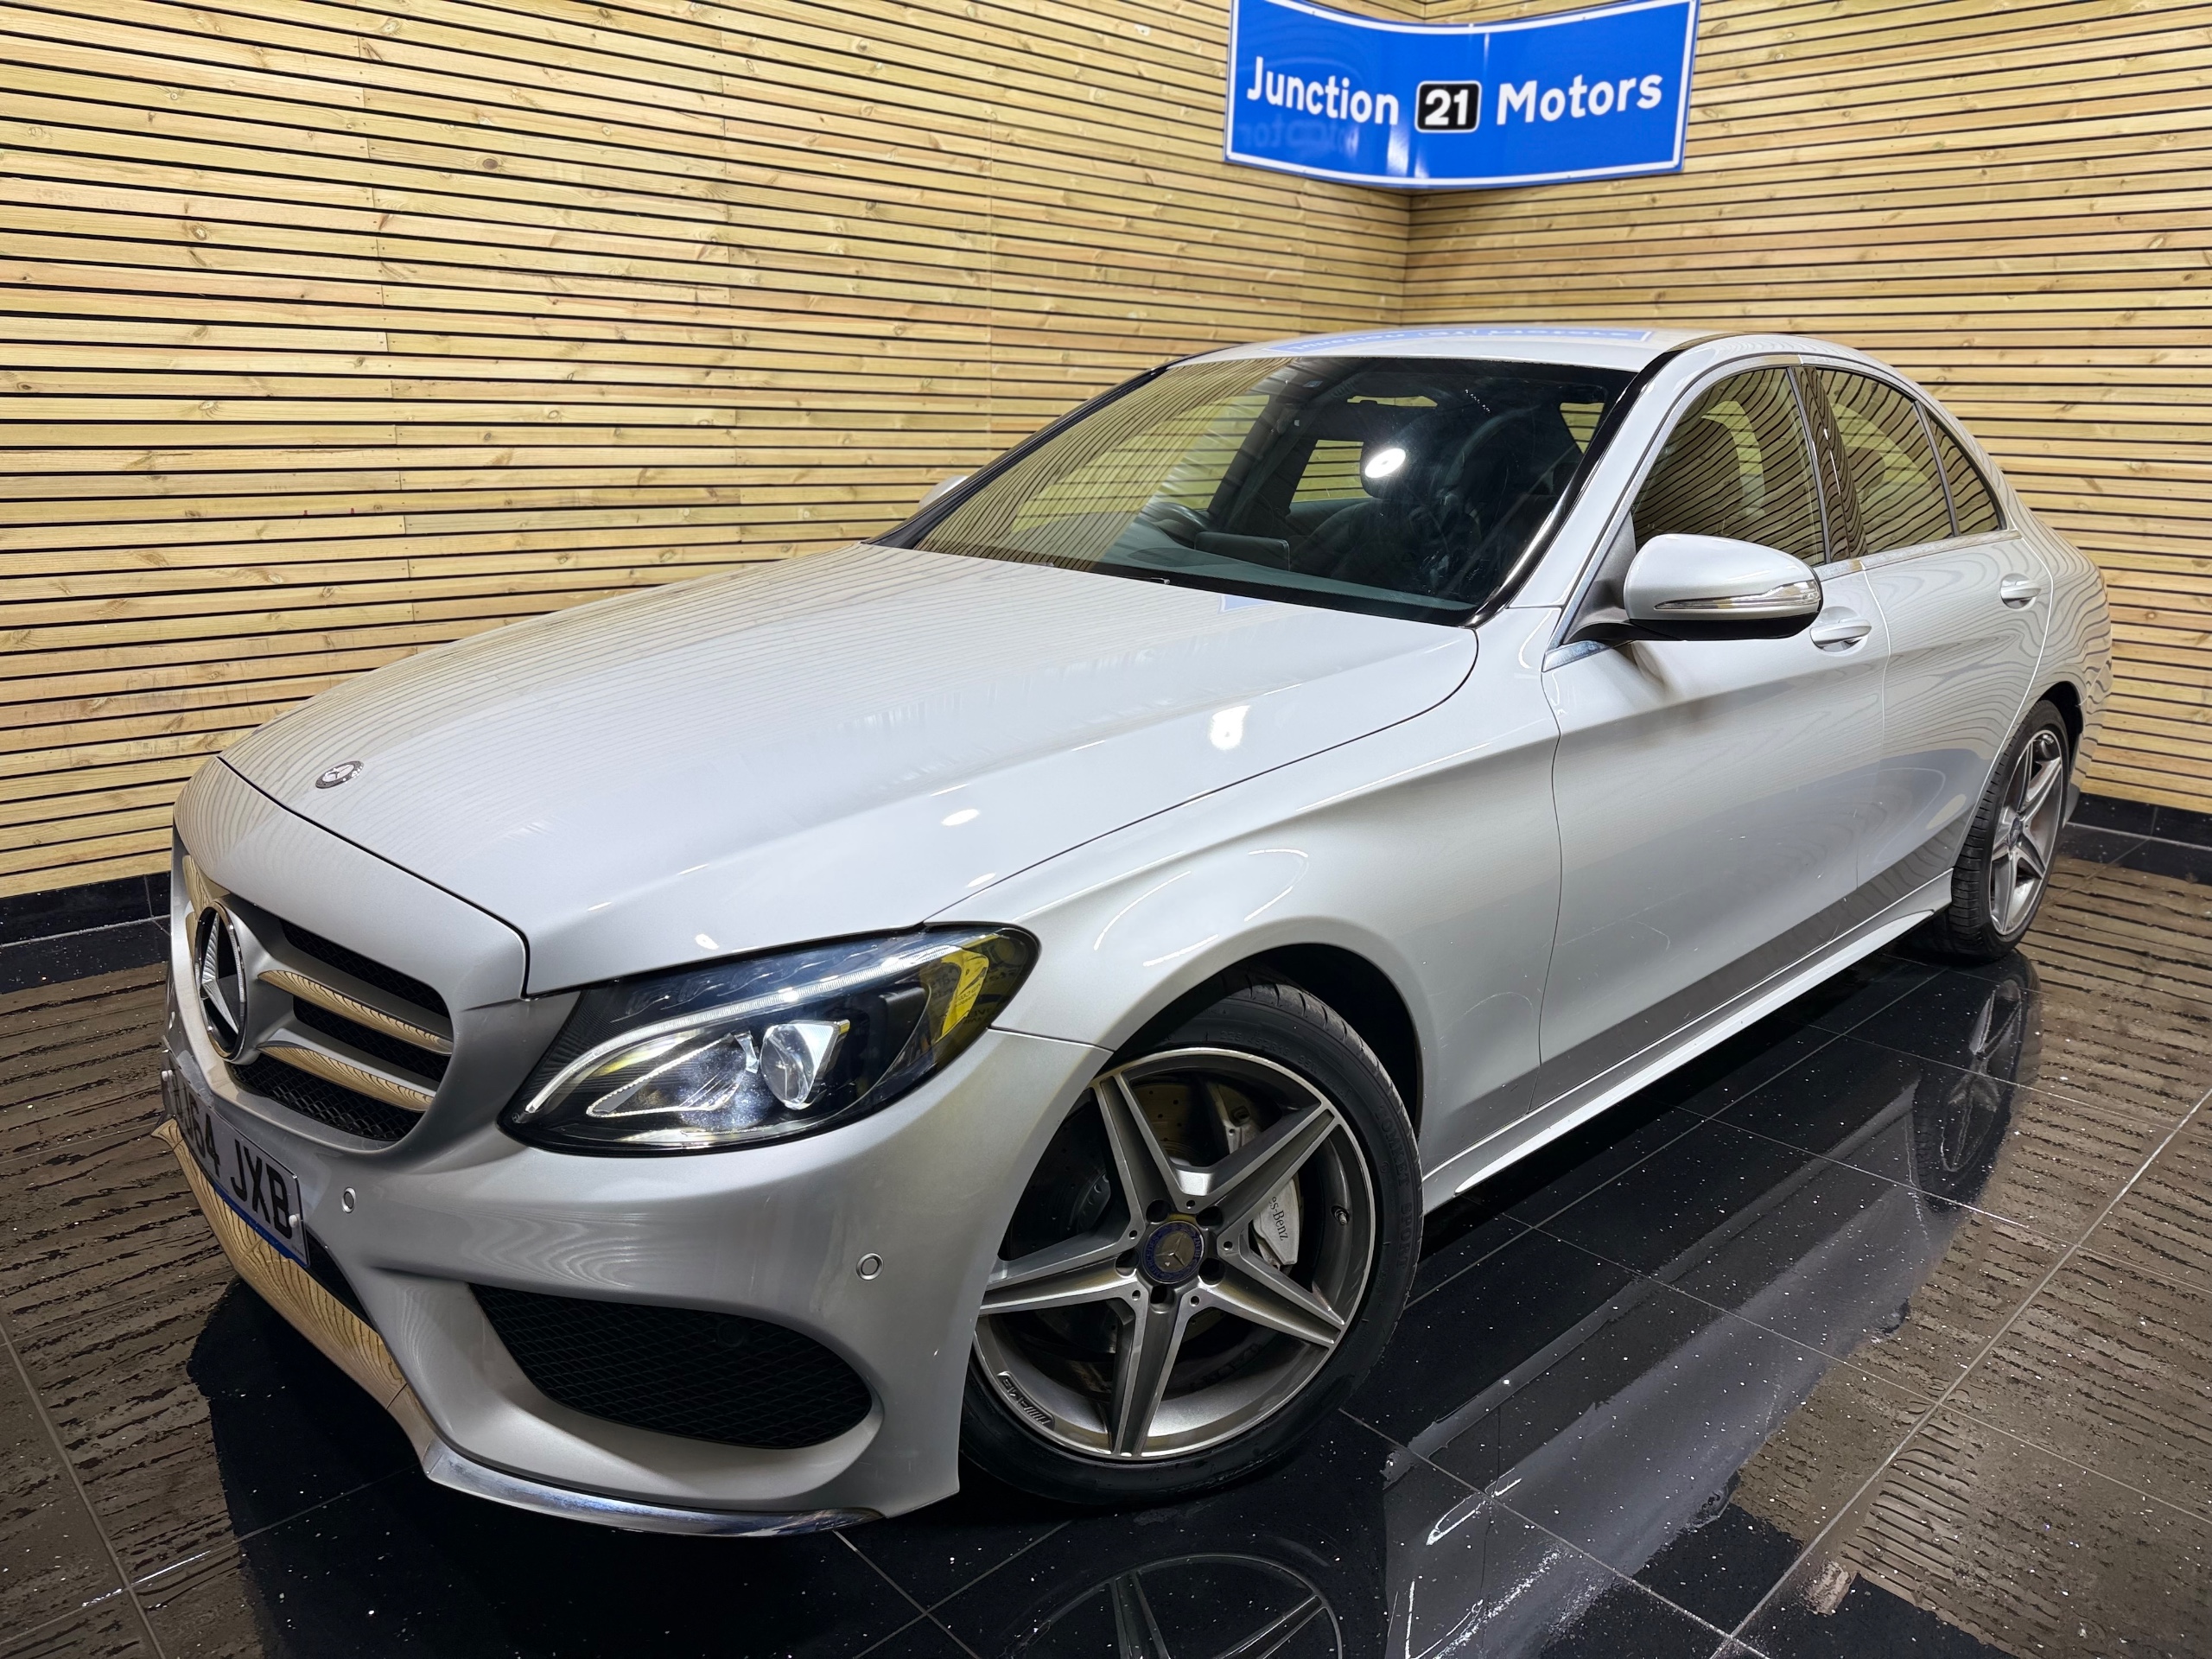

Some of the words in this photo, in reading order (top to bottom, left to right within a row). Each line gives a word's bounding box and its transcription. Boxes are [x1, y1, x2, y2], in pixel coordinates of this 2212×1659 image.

[1247, 56, 1399, 125] Junction
[1424, 89, 1468, 125] 21
[1497, 73, 1663, 125] Motors
[230, 1138, 293, 1240] JXB
[1145, 1235, 1162, 1277] MERCEDES
[1193, 1235, 1202, 1258] BENZ
[1396, 1202, 1414, 1270] SPORT
